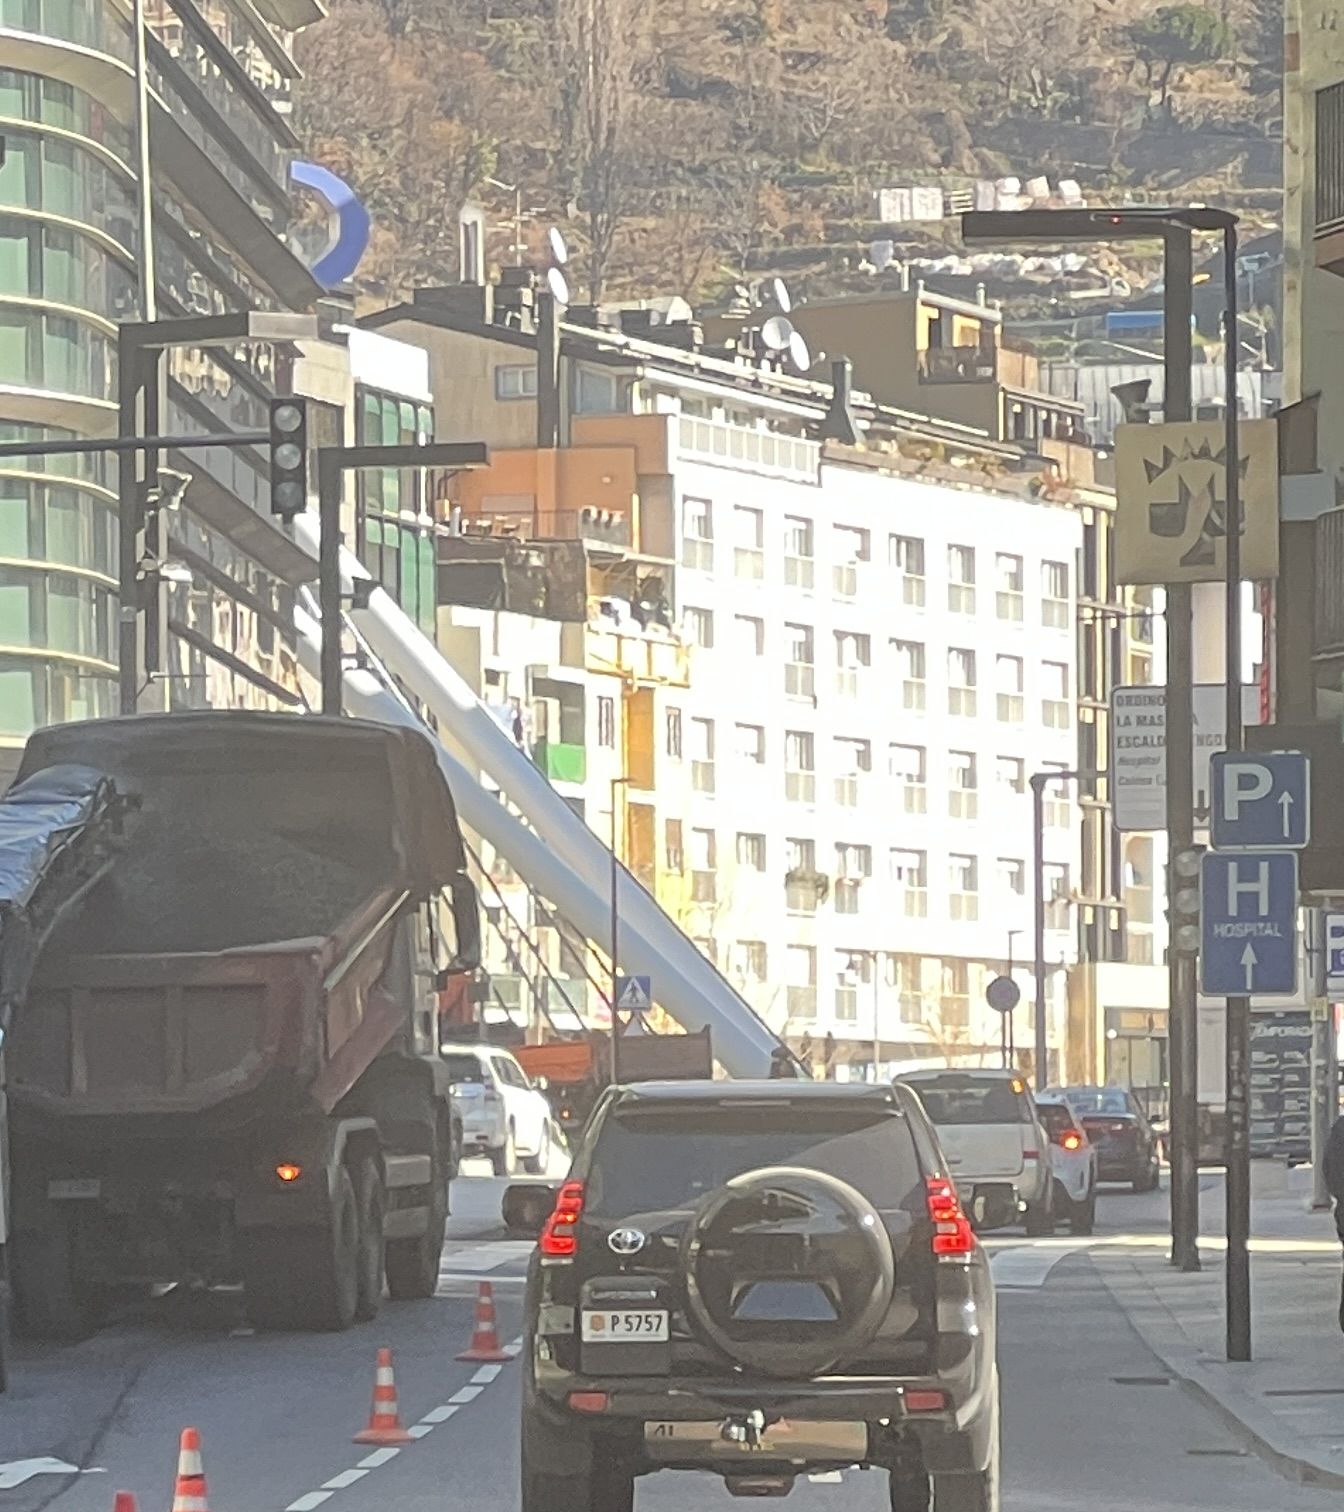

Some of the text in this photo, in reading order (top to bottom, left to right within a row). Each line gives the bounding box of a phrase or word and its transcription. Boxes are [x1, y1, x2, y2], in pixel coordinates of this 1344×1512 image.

[1224, 763, 1273, 821] P
[1227, 860, 1269, 917] H
[1213, 923, 1282, 938] HOSPITAL
[624, 1314, 663, 1331] 5757
